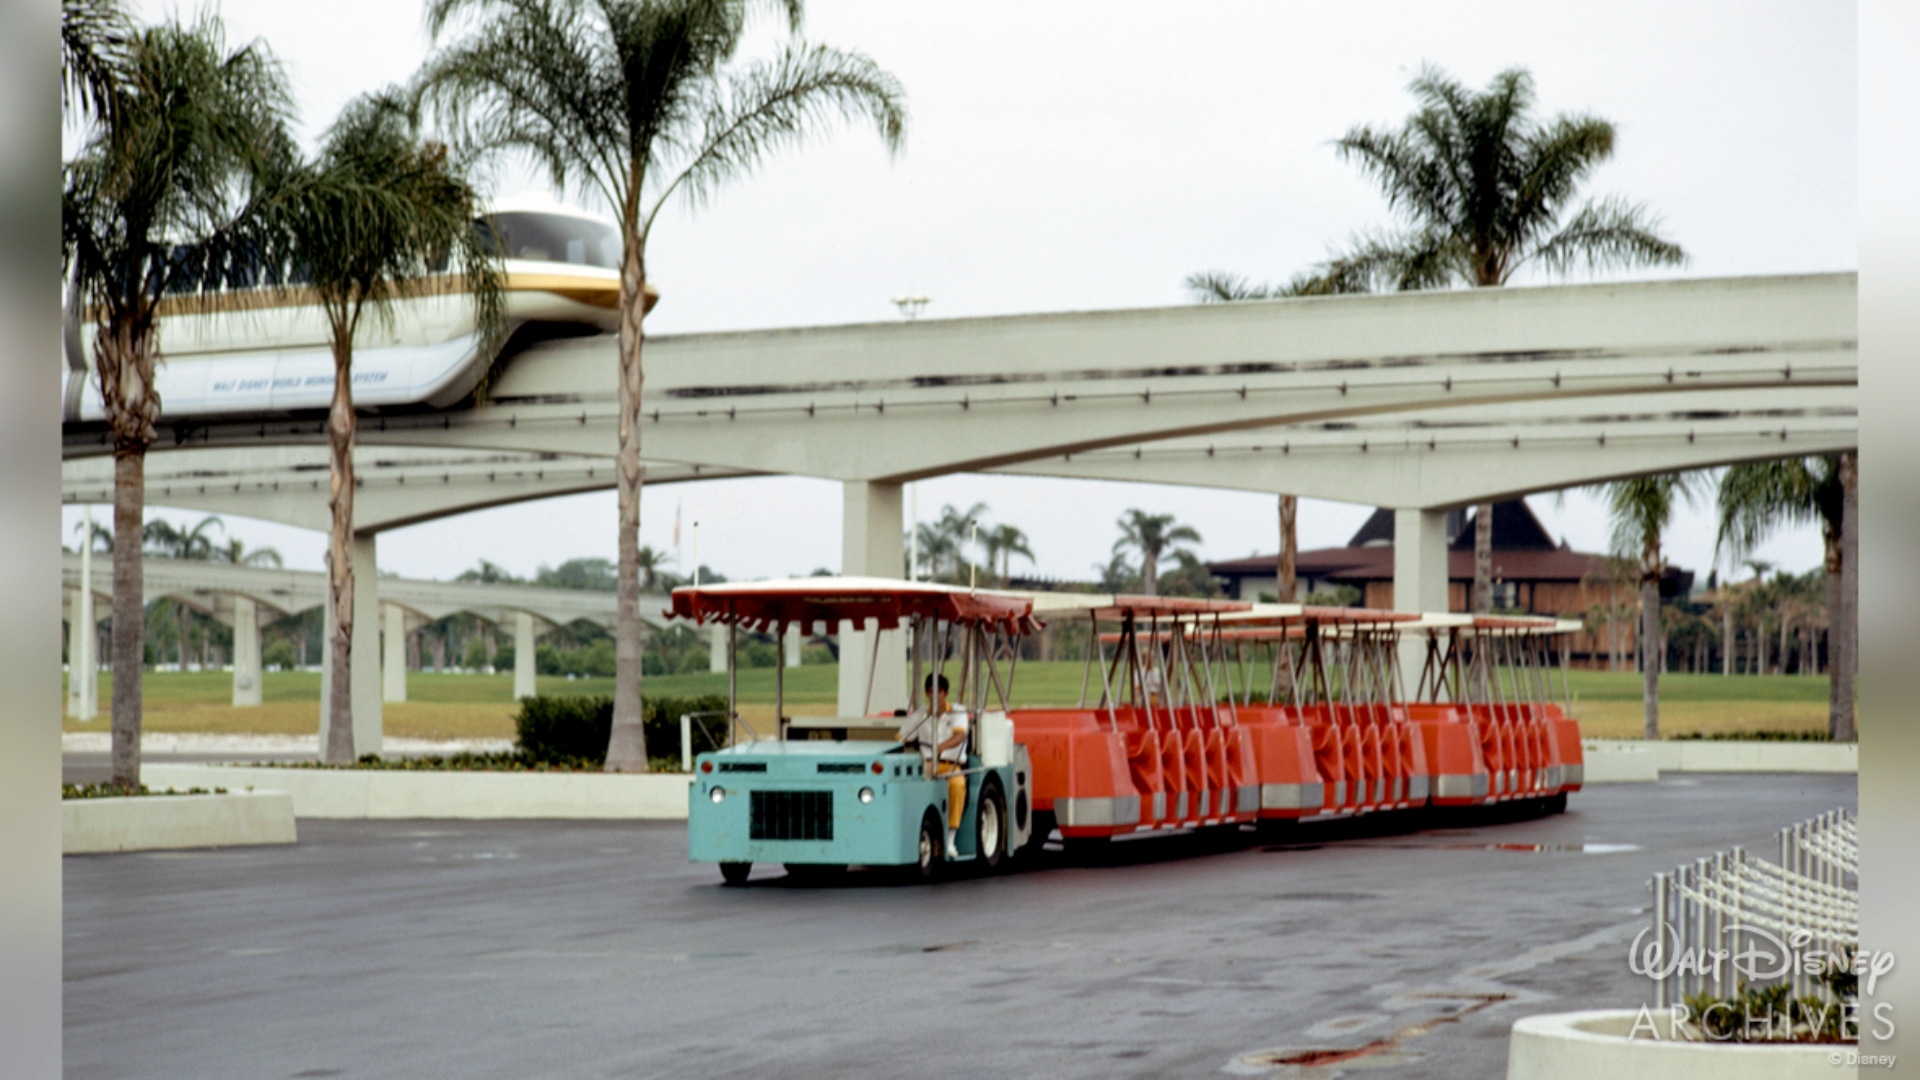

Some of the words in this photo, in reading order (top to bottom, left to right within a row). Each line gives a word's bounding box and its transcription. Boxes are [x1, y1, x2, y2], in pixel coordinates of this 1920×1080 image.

[213, 380, 236, 391] WALT
[238, 379, 270, 391] DISNEY
[272, 377, 302, 388] WORLD
[353, 371, 389, 383] SYSTEM
